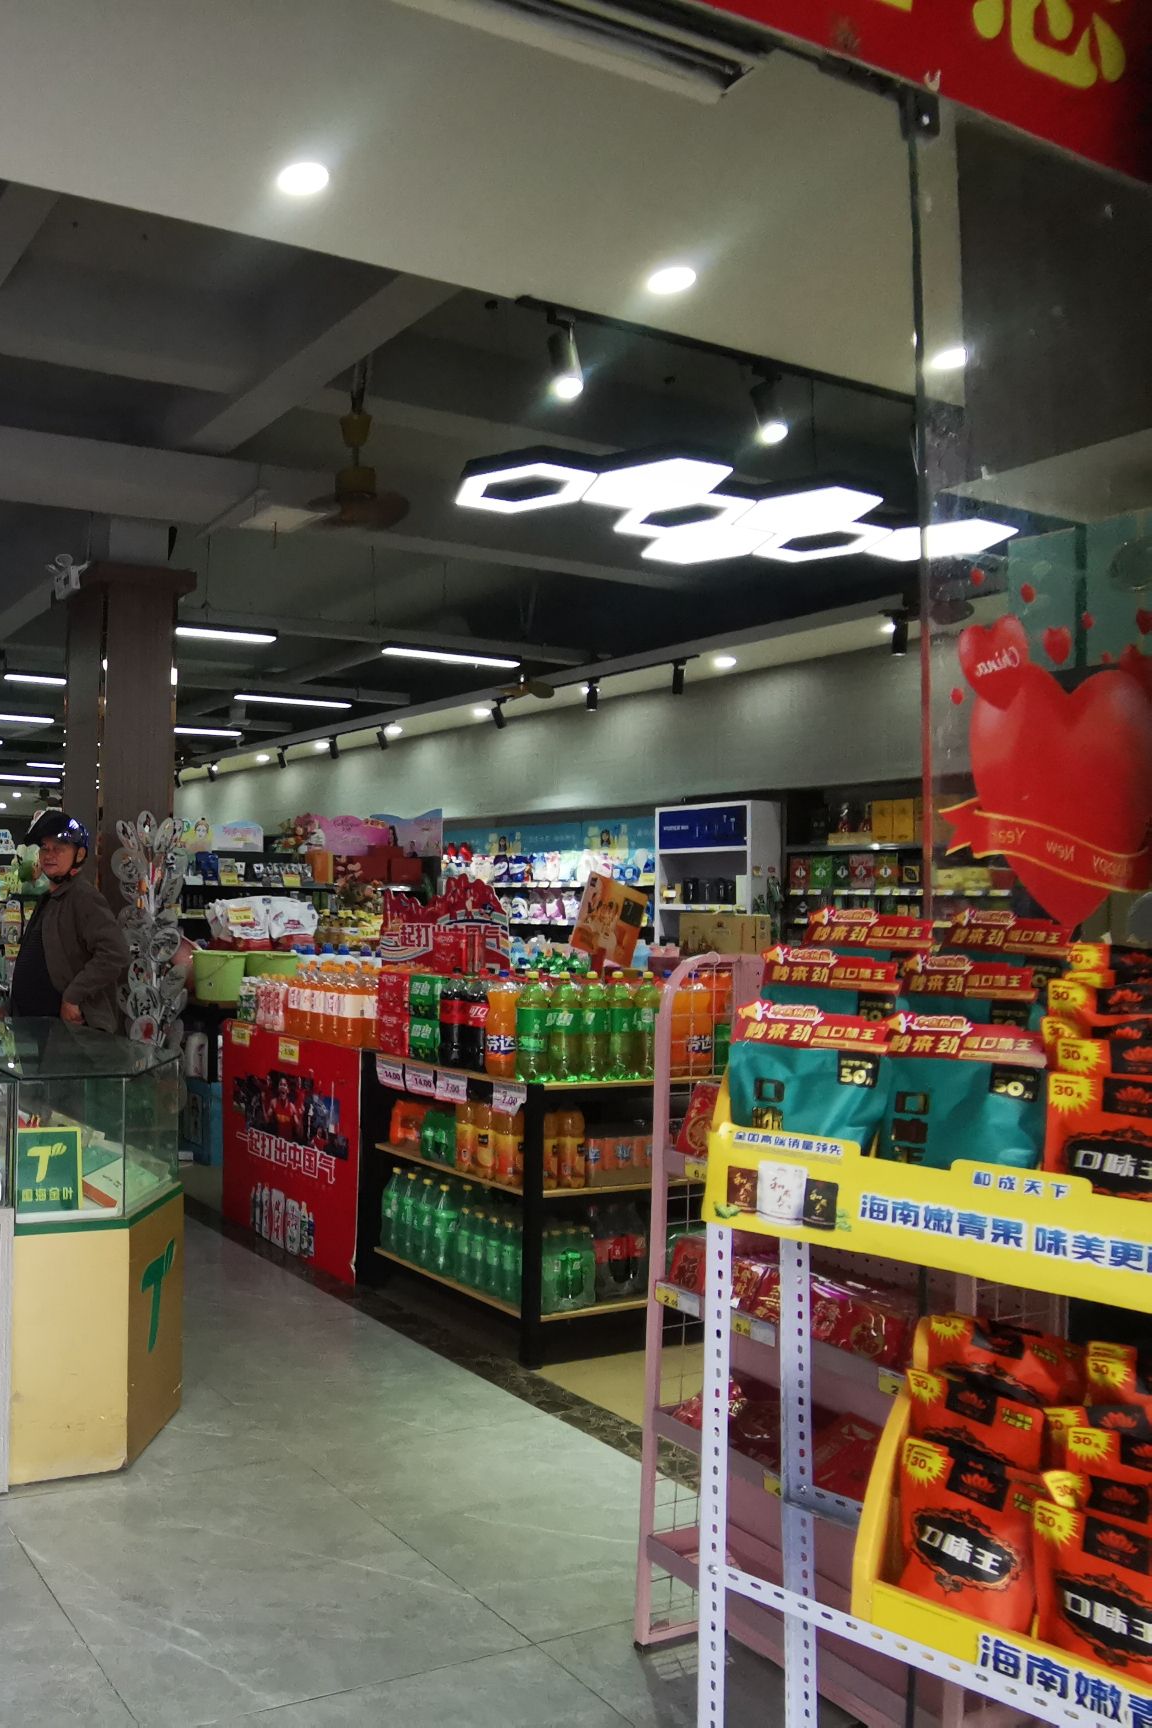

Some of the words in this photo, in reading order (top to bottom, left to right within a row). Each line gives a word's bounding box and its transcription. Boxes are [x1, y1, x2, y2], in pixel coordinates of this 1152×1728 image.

[486, 1034, 516, 1053] 芬达
[236, 1127, 336, 1184] 一起打出中国气
[973, 1171, 1069, 1198] 和成天下
[860, 1194, 1025, 1249] 海南嫩青果
[1034, 1226, 1152, 1274] 味美更
[919, 1524, 1003, 1576] 口味王
